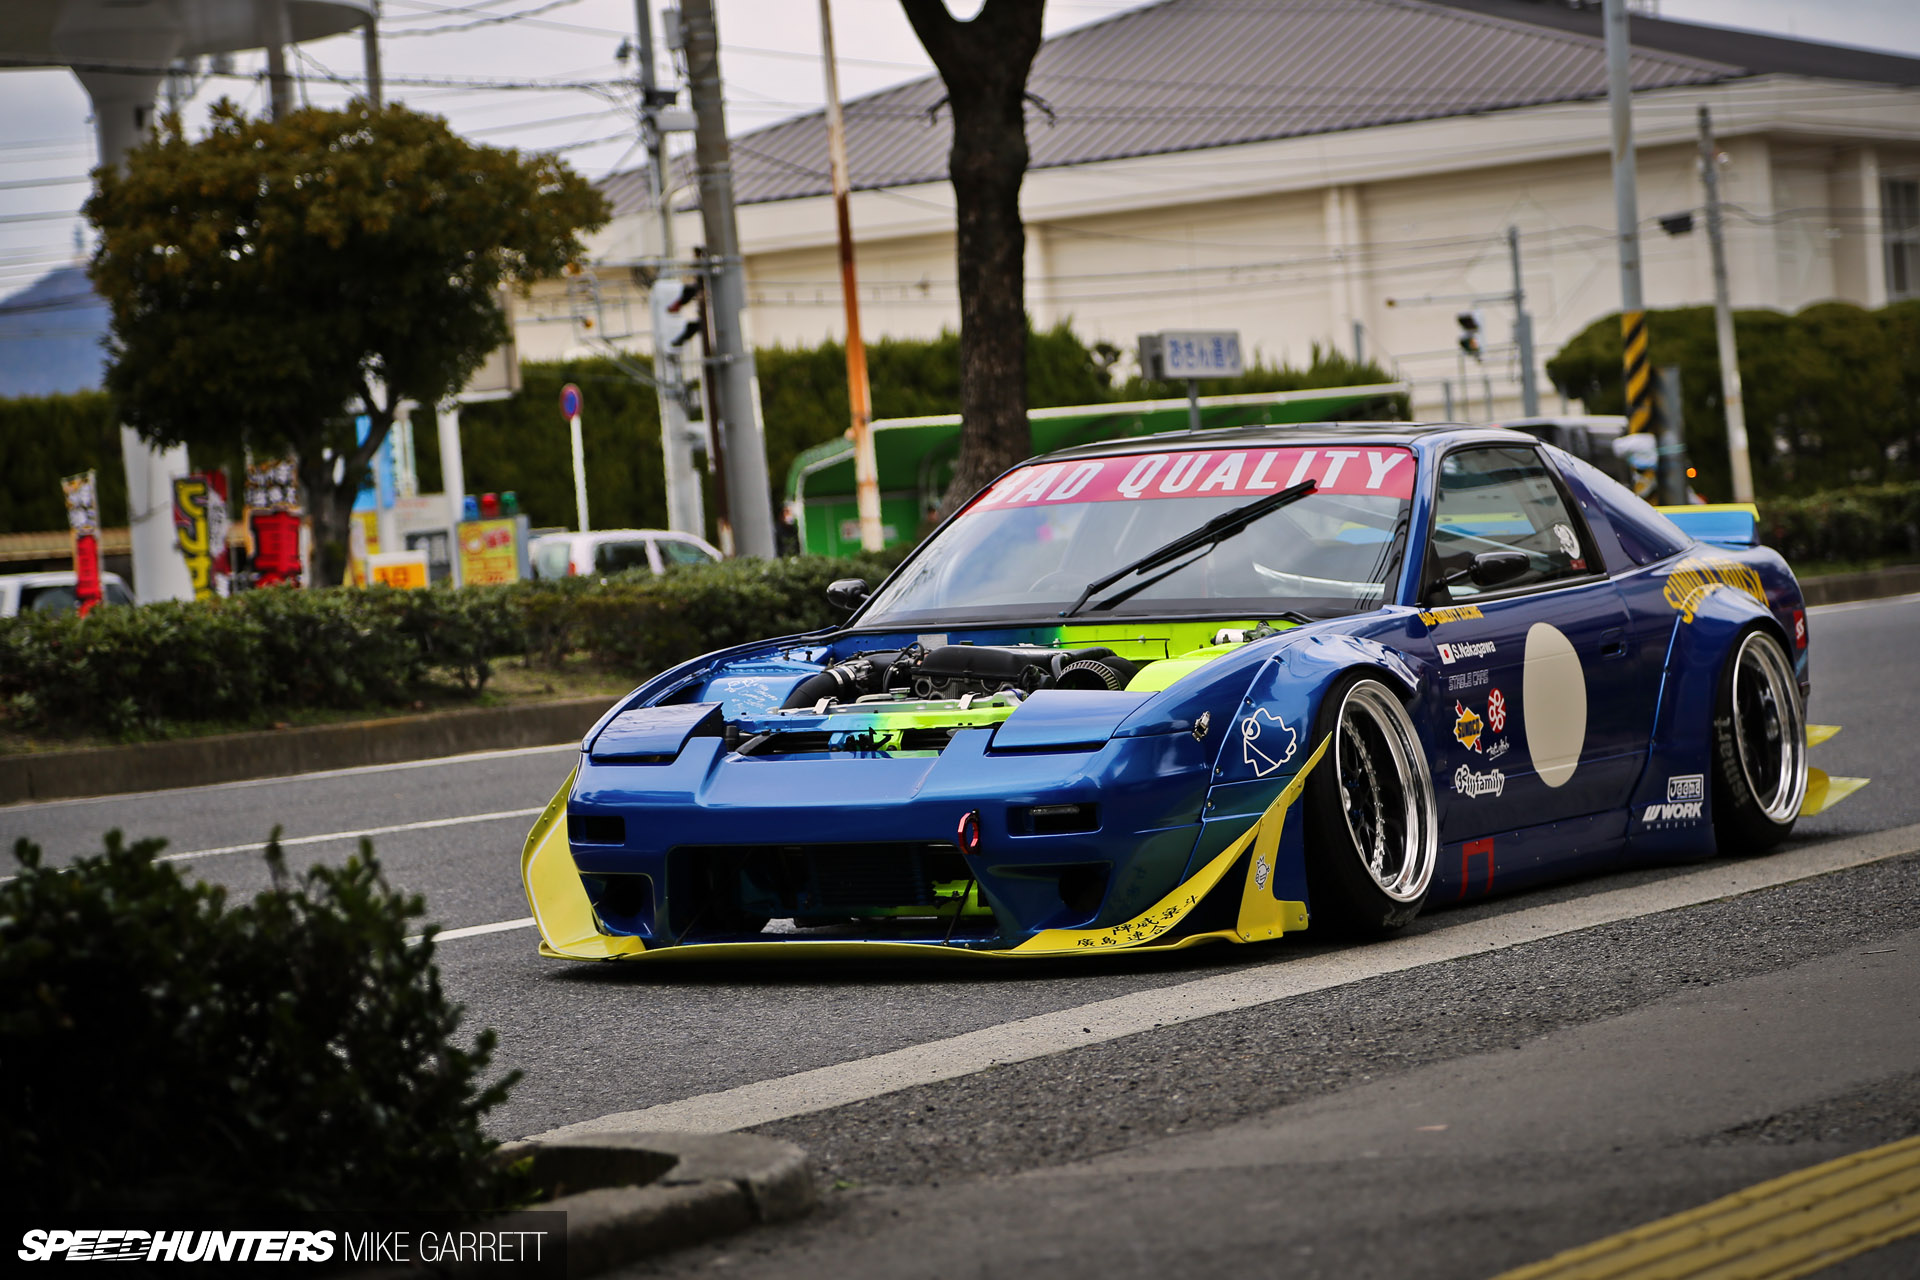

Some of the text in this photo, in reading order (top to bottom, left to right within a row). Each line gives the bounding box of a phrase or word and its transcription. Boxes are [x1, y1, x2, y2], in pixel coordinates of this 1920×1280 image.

[976, 451, 1408, 507] BAD QUALITY
[1451, 640, 1497, 660] S.Nakagawa
[1661, 802, 1703, 820] WORK
